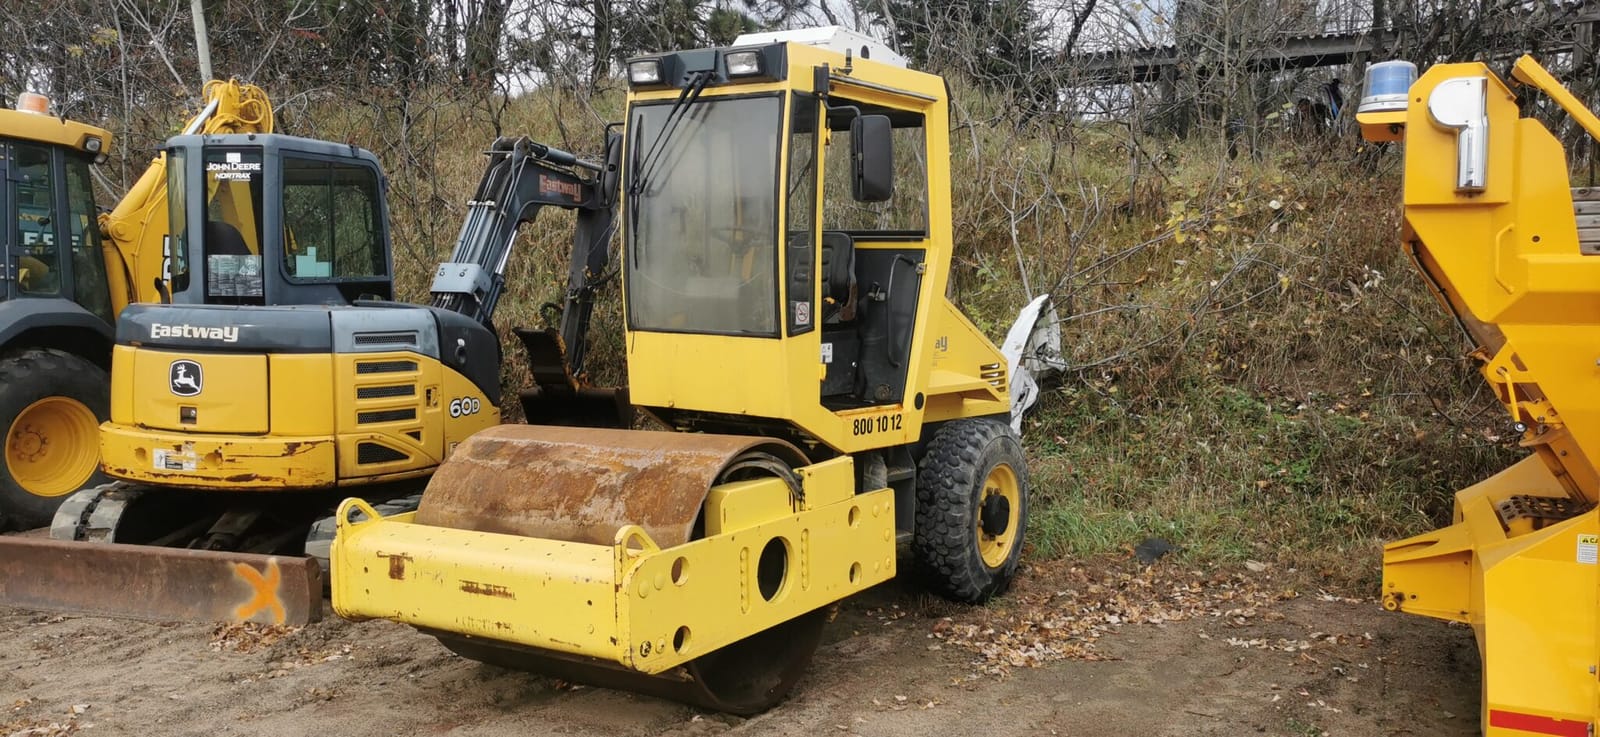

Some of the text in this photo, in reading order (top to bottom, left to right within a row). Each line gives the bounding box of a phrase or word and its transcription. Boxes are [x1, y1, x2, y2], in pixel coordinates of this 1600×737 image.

[206, 162, 261, 171] JOHN DEERE
[214, 172, 251, 180] NORTRAX
[539, 174, 582, 202] Eastway
[150, 323, 239, 343] Eastway
[449, 396, 481, 418] 60D
[853, 413, 902, 436] 800 10 12
